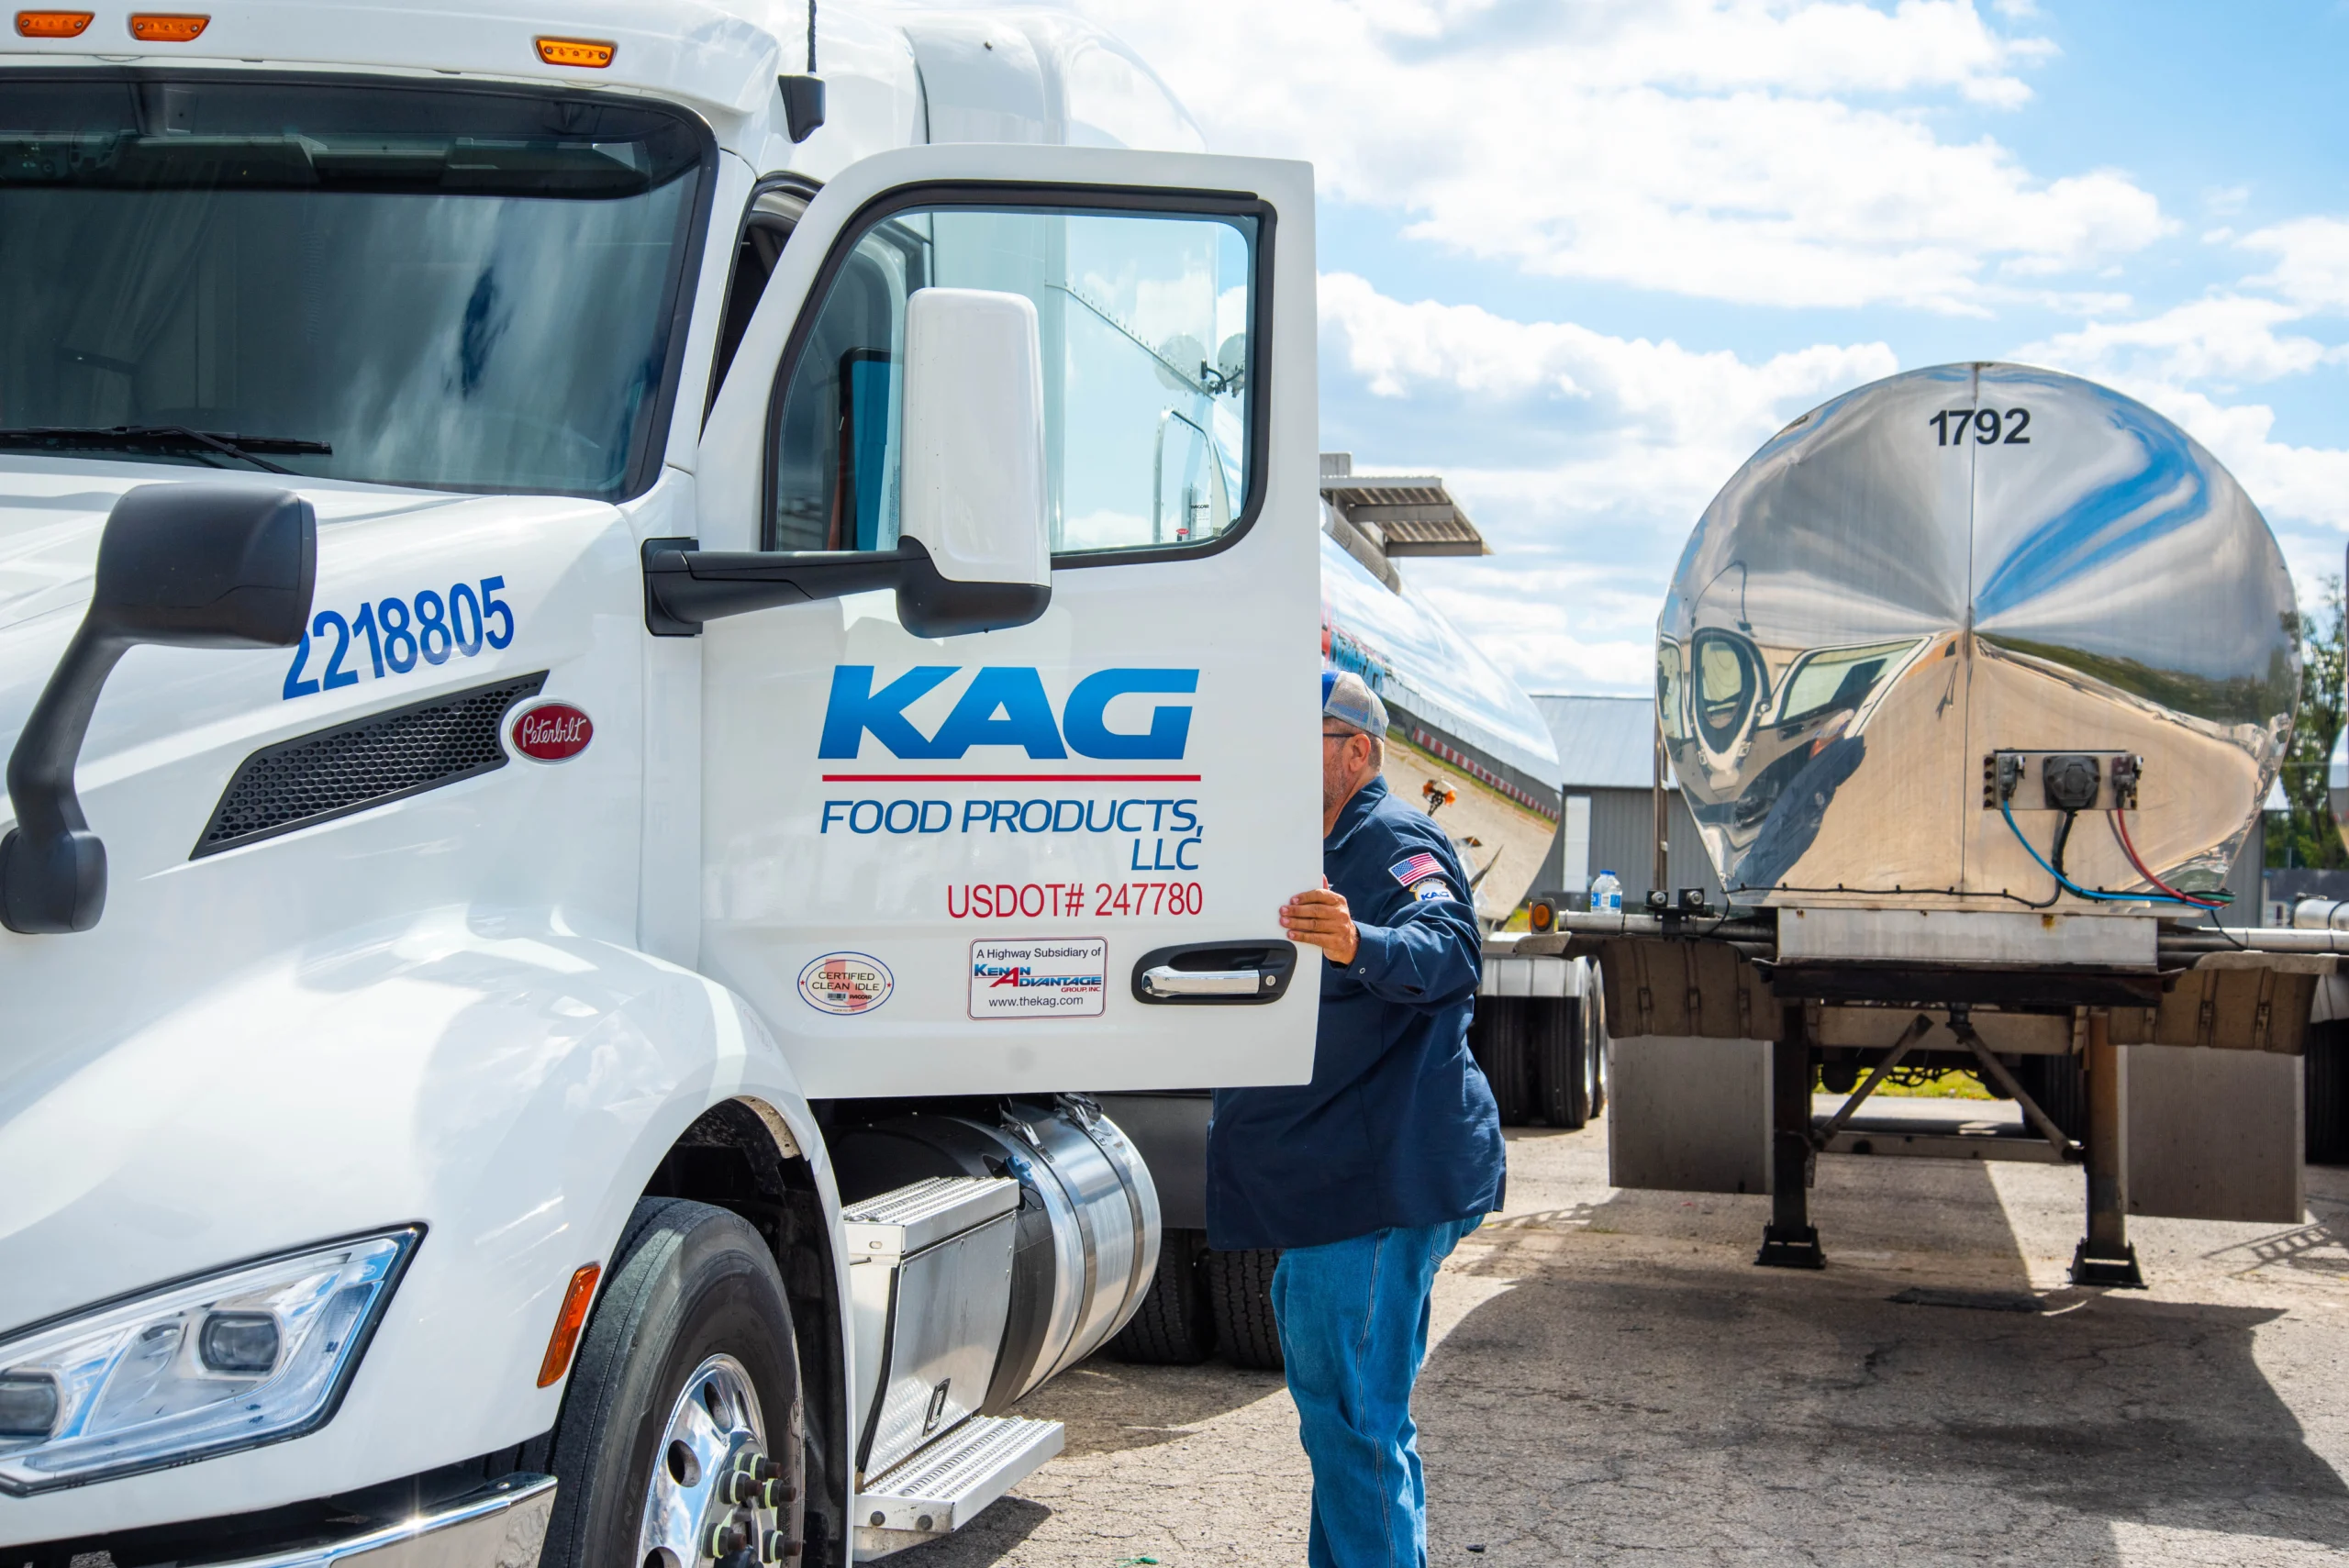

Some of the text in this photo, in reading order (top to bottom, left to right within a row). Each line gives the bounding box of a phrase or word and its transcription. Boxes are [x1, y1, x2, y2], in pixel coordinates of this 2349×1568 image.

[1930, 407, 2031, 446] 1792
[283, 575, 515, 700] 2218805
[818, 665, 1199, 760] KAG
[522, 715, 587, 748] Peterbilt
[820, 798, 1203, 836] FOOD PRODUCTS,
[1131, 838, 1201, 871] LLC
[948, 882, 1203, 918] USDOT# 247780
[976, 947, 1102, 961] A Highway Subsidiary of
[811, 982, 880, 991] CLEAN IDLE
[818, 971, 875, 981] CERTIFIED
[988, 995, 1084, 1008] www.thekag.com
